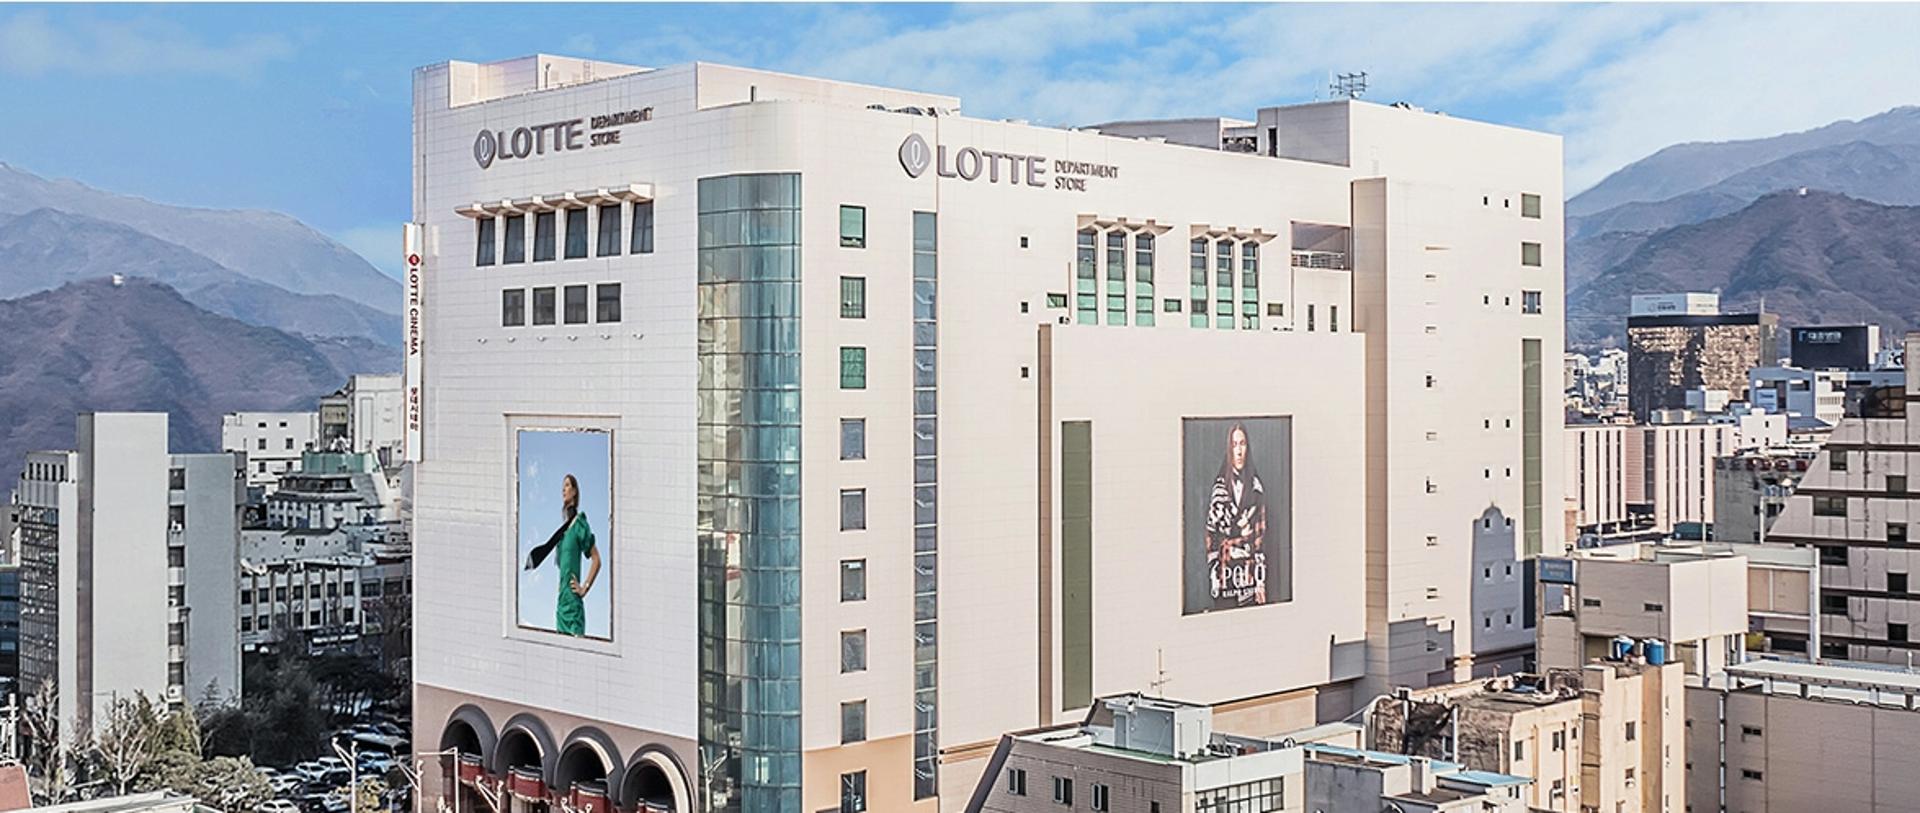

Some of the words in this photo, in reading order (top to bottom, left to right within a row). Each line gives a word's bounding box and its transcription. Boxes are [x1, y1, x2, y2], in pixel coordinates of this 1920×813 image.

[590, 106, 654, 130] DEPARTMENT
[497, 118, 583, 160] LOTTE
[590, 130, 620, 147] STORE
[937, 145, 1046, 187] LOTTE
[1055, 160, 1119, 178] DEPARTMENT
[1055, 177, 1086, 192] STORE
[409, 268, 418, 306] LOTTE
[409, 308, 419, 355] CINEMA
[1222, 563, 1266, 589] POLO
